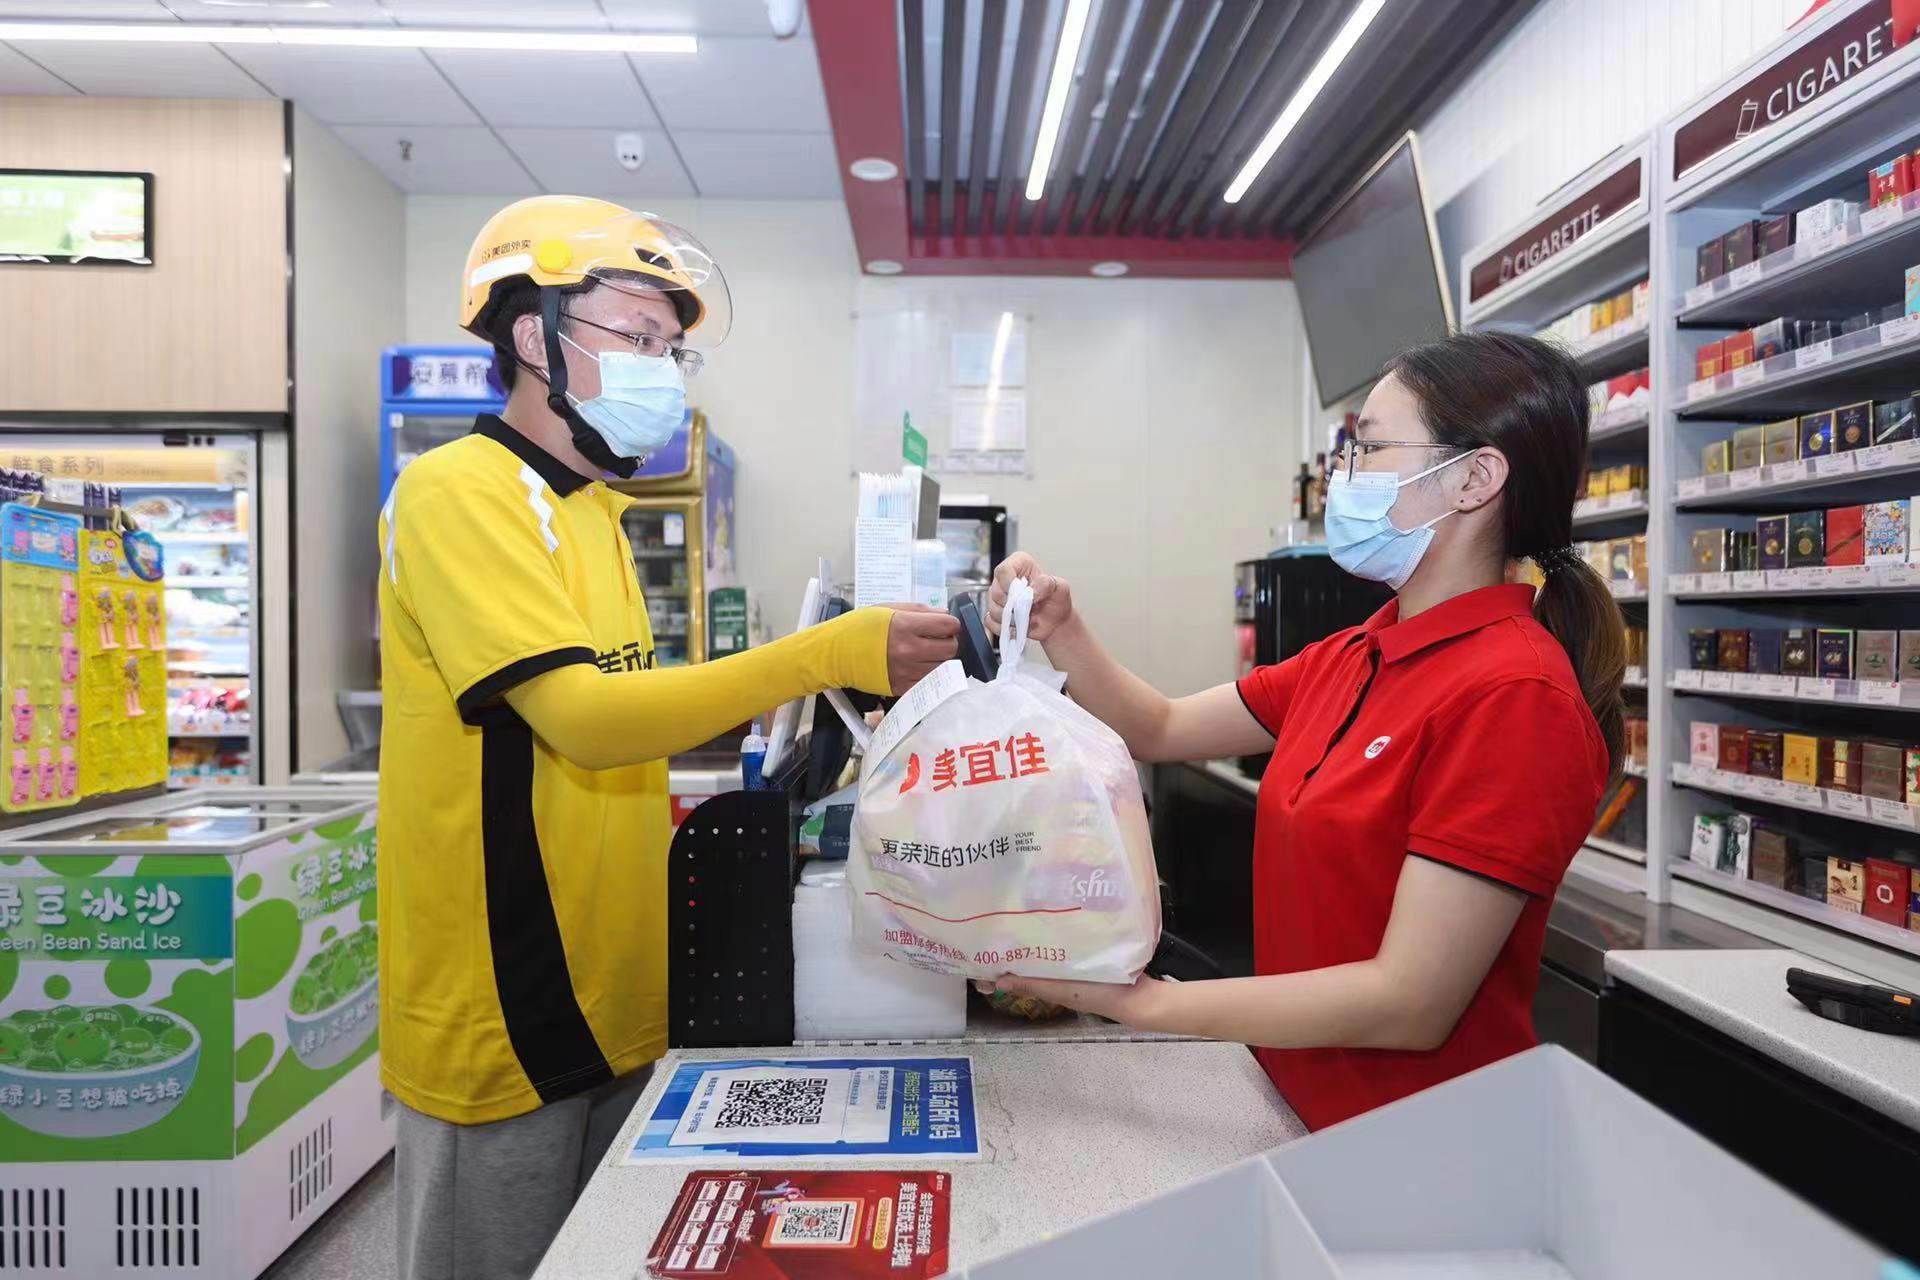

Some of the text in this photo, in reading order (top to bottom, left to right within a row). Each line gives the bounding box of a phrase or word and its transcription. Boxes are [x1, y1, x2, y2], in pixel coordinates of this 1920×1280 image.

[1767, 18, 1920, 120] CIGARE
[1514, 204, 1600, 275] CIGARETTE
[14, 455, 104, 475] 鲜食系列
[880, 836, 1009, 868] 更亲近的伙伴
[1016, 845, 1041, 853] FRIEND
[0, 930, 182, 950] een Bean Sand Ice
[973, 946, 1066, 964] 400-887-1133
[0, 1078, 183, 1110] 绿小豆想被吃掉
[928, 1068, 961, 1139] 湖南场所码
[891, 1182, 918, 1267] 美宜佳优选上线啦
[916, 1192, 934, 1255] 会员平台全新升级
